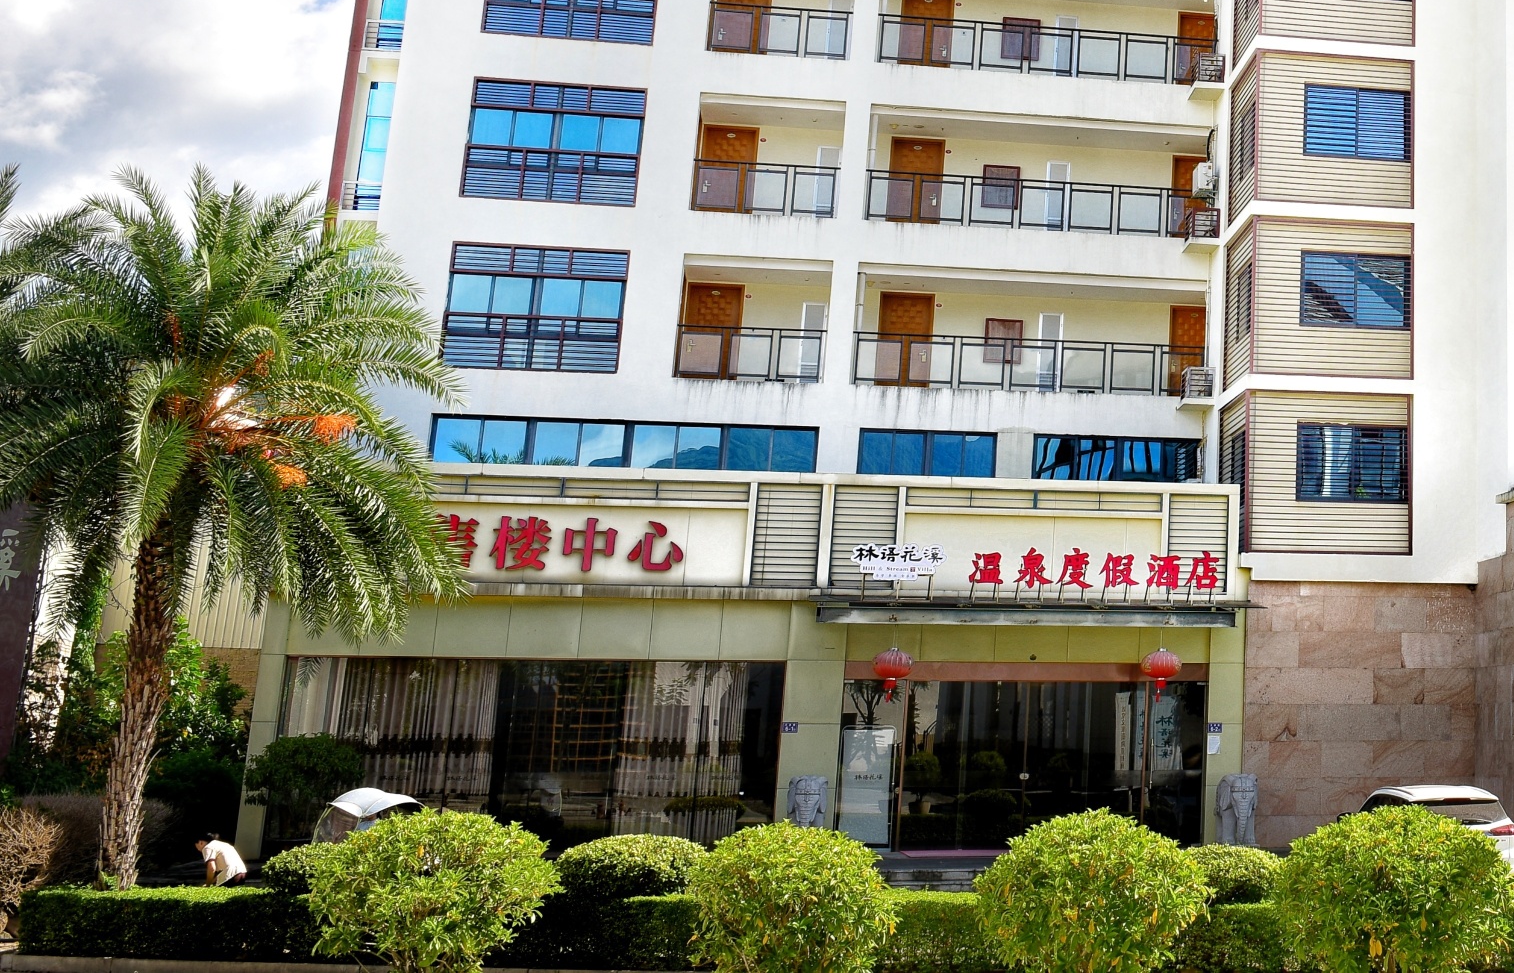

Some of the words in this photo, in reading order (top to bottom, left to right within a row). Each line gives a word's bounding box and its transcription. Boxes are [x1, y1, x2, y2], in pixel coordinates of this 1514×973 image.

[854, 545, 943, 564] 林语花溪
[968, 547, 1220, 591] 温泉度假酒店
